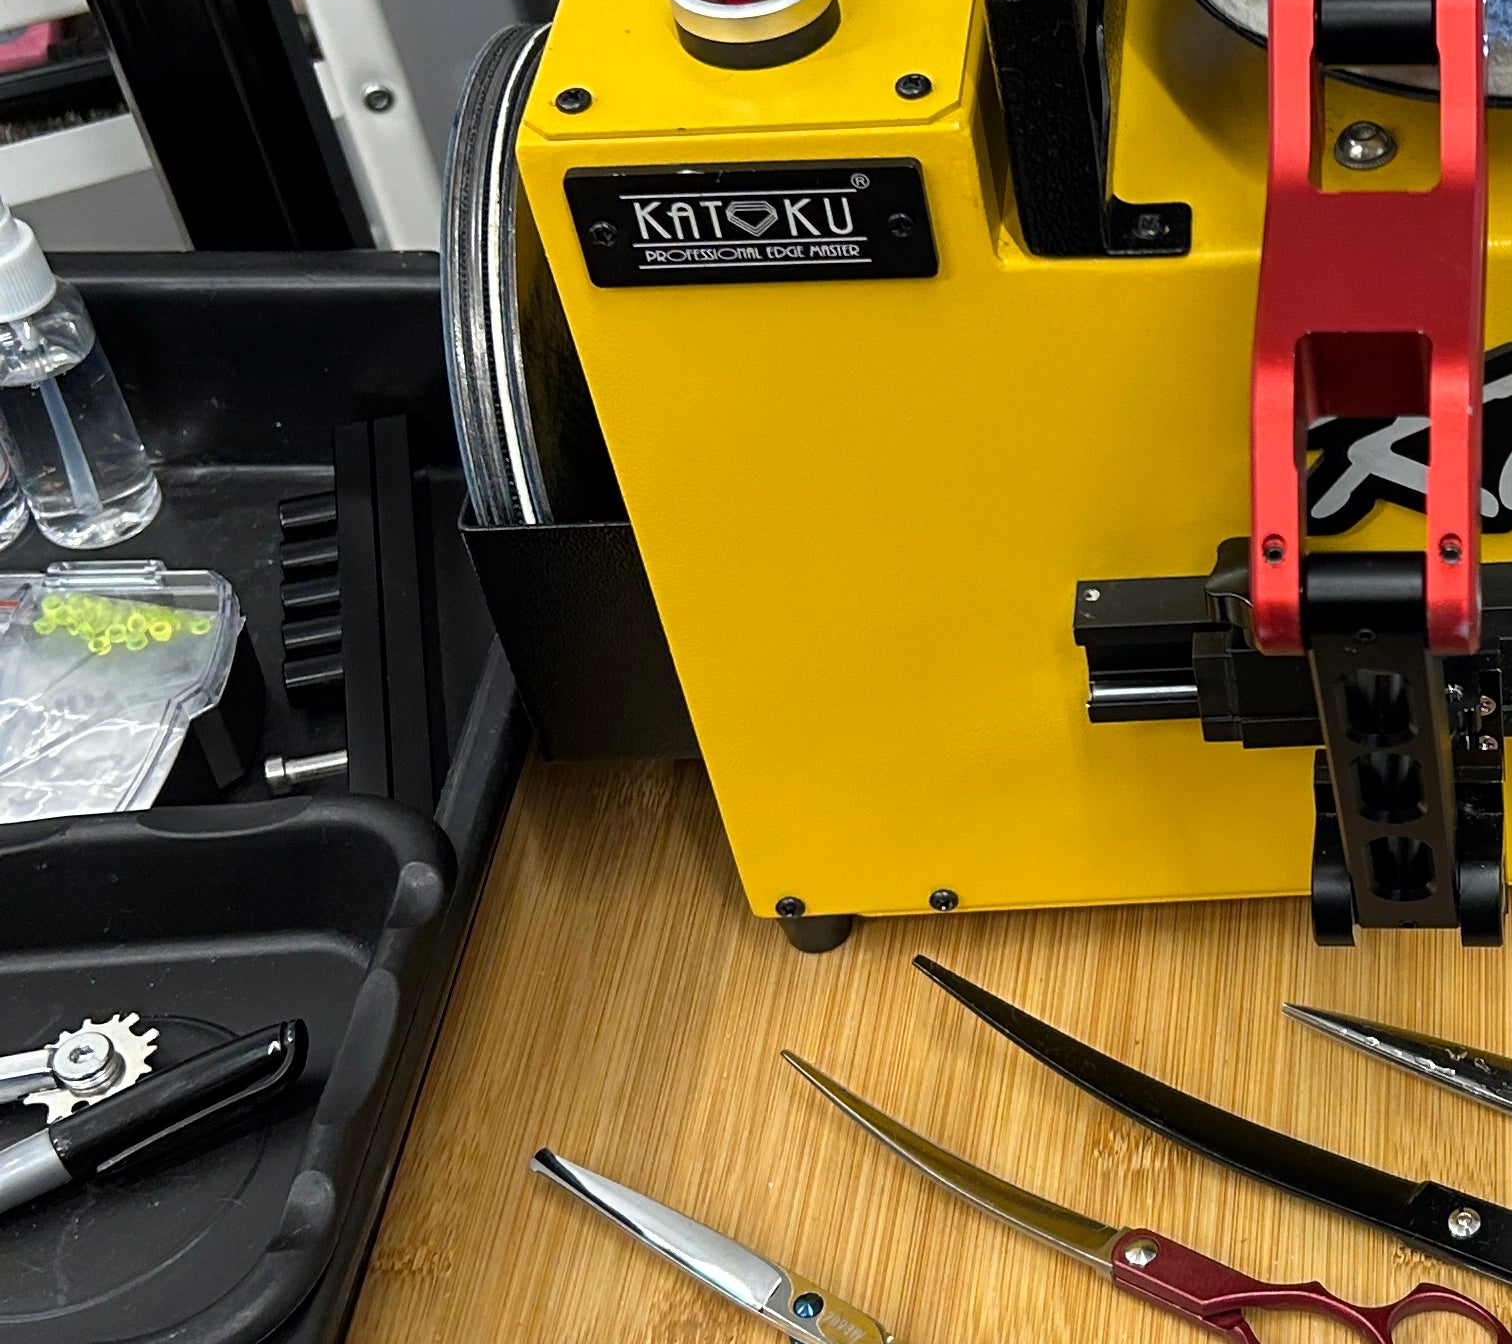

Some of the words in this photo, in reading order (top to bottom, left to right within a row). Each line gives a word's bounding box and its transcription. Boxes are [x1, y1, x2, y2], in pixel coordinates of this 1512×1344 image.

[644, 248, 763, 263] PROFESSIONAL
[765, 246, 805, 260] EDGE
[809, 244, 861, 258] MASTER
